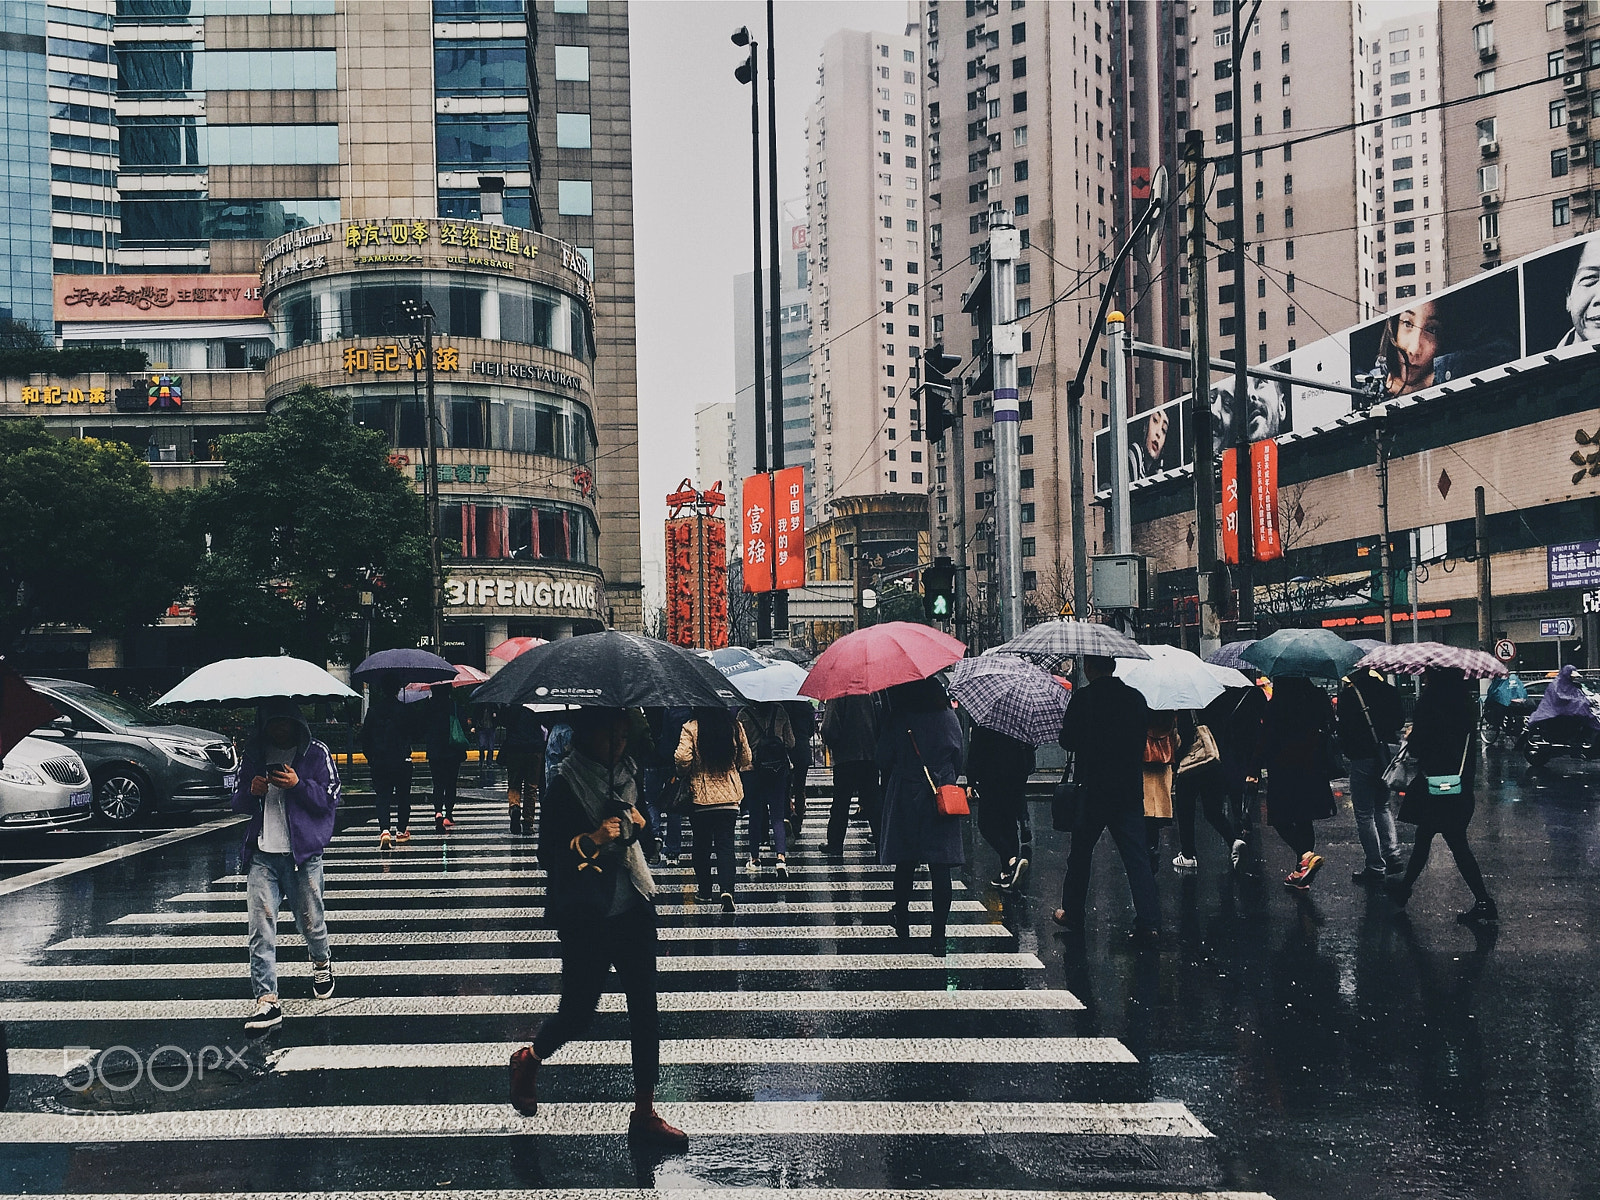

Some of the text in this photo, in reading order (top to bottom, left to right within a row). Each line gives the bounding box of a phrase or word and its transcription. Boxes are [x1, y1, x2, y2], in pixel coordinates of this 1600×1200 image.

[447, 256, 514, 270] OIL MASSAGE
[522, 244, 540, 259] 4F
[472, 360, 583, 391] HEJI RESTAURANT
[789, 483, 800, 531] 中国梦
[778, 518, 788, 566] 我的梦
[444, 578, 597, 610] BIFENGTANG
